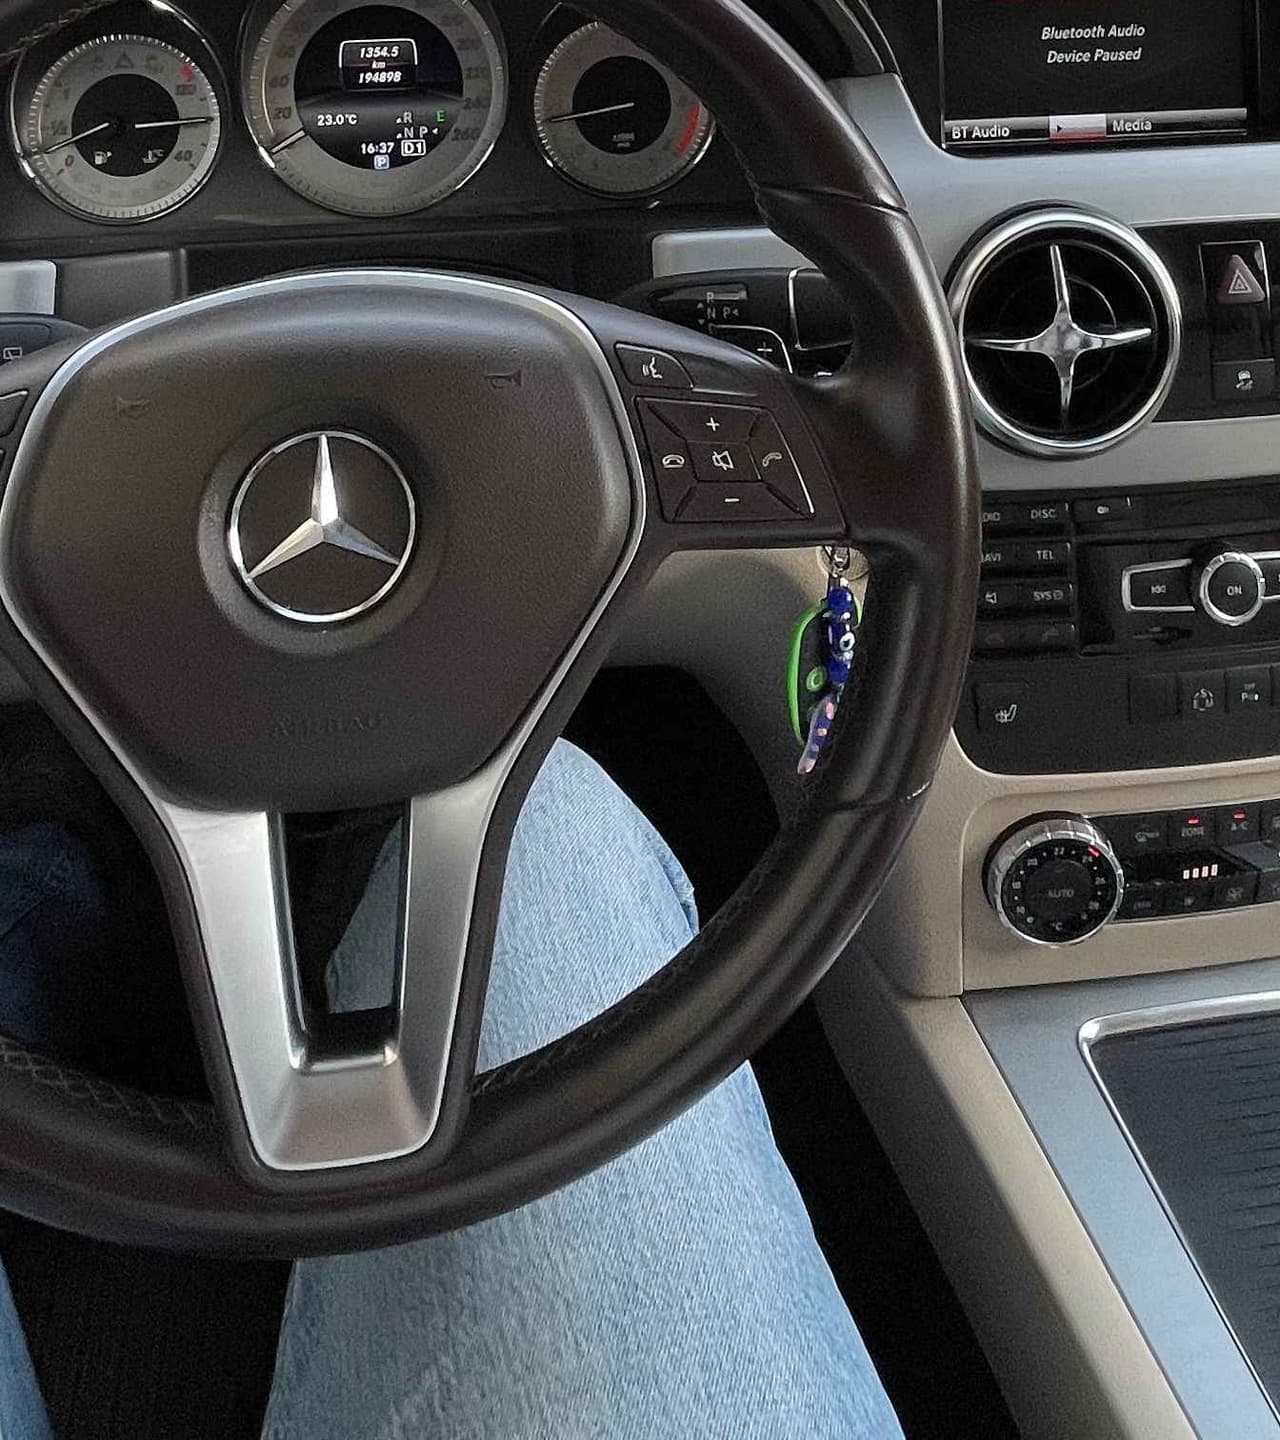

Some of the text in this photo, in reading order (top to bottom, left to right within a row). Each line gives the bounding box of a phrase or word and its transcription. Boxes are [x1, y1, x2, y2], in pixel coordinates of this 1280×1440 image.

[1041, 23, 1145, 40] Bluetooth Audio
[360, 45, 399, 59] 1354.5
[1046, 46, 1142, 64] Device Paused
[358, 71, 402, 84] 194898
[317, 113, 358, 126] 23.0°C
[403, 111, 413, 124] R
[436, 110, 446, 122] E
[1112, 117, 1152, 132] Media
[403, 126, 429, 139] N P
[951, 123, 1010, 140] BT Audio
[360, 142, 395, 154] 16:37
[1030, 508, 1057, 520] DISC
[1036, 550, 1054, 561] TEL
[1226, 585, 1243, 596] ON
